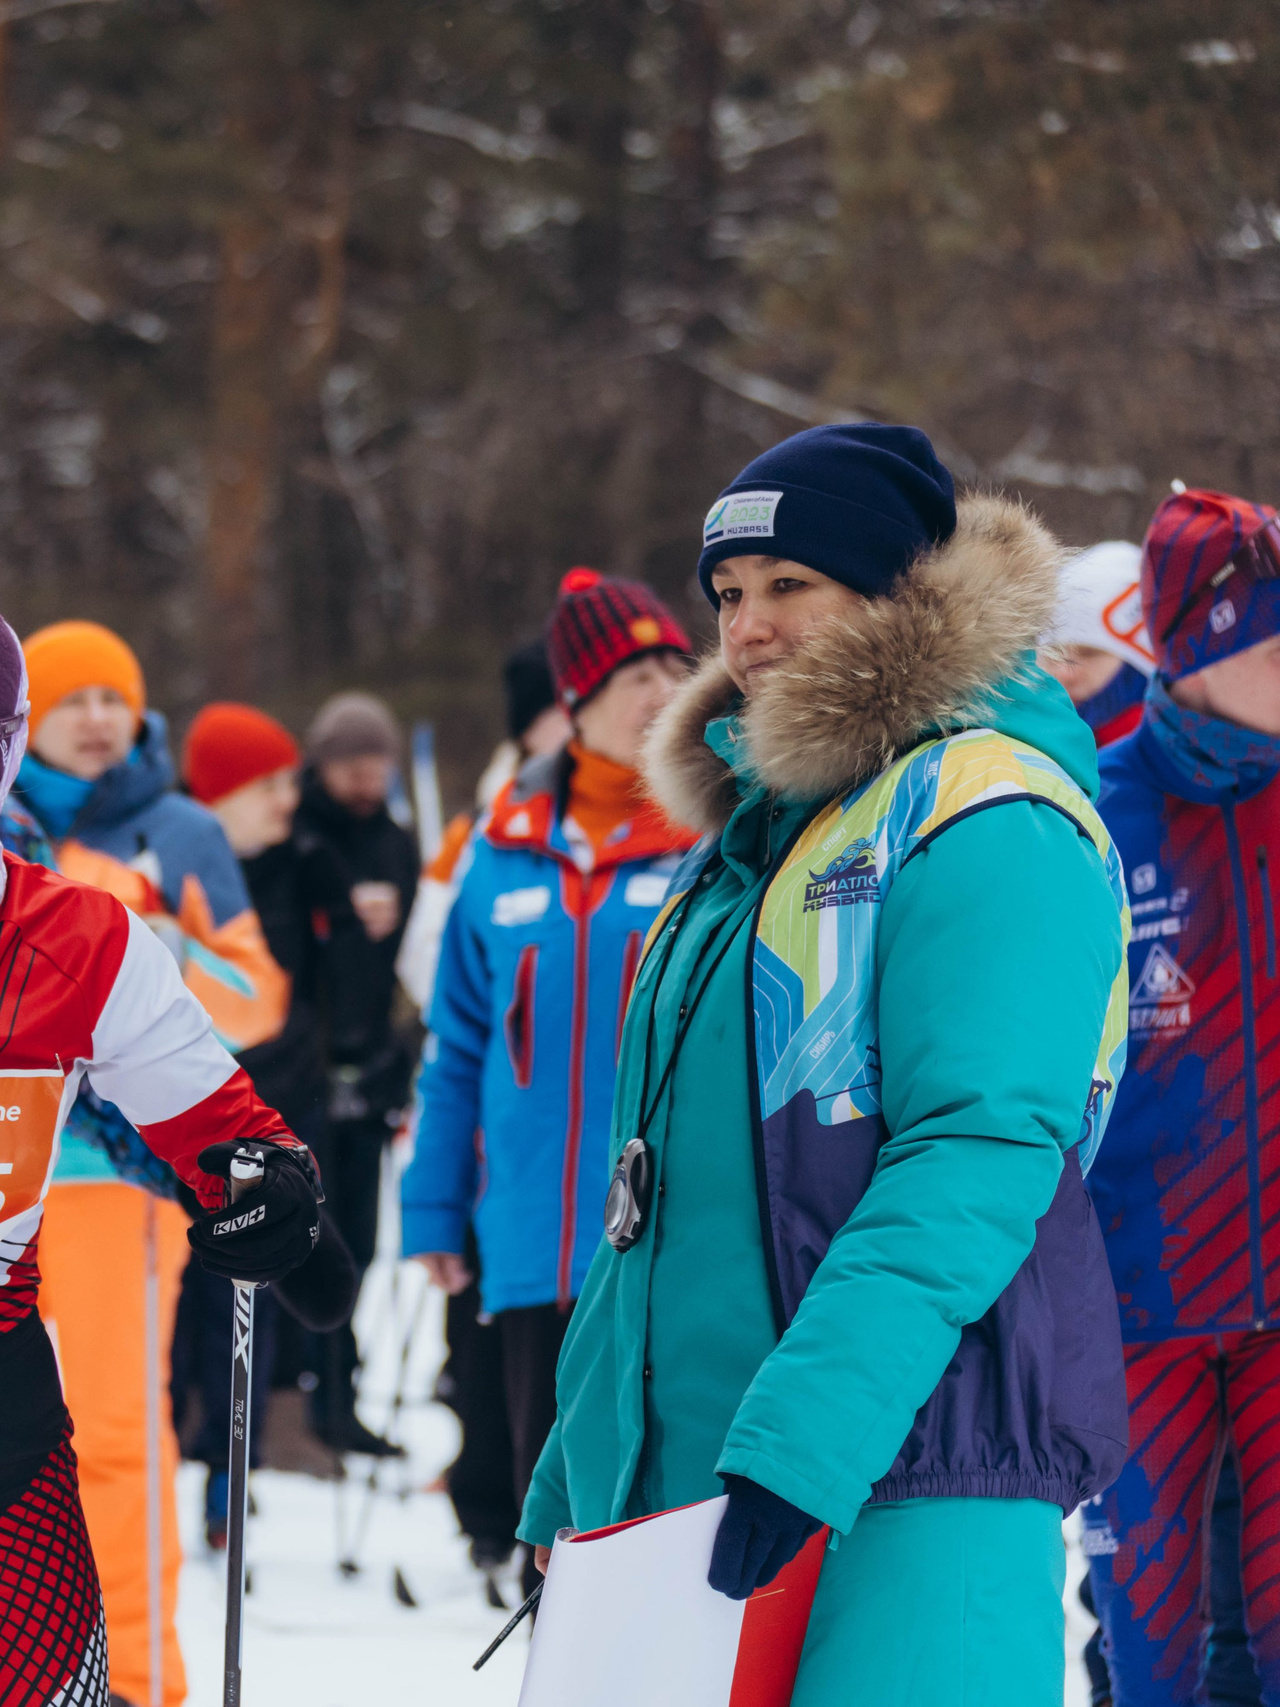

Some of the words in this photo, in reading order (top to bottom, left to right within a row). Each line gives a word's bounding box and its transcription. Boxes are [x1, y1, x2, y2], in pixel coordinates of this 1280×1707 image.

[729, 506, 771, 522] 2023
[727, 525, 769, 535] KUZBASS
[822, 826, 847, 852] СПОРТ
[808, 874, 880, 897] ТРИАТЛО
[802, 890, 881, 913] КУЗБАС
[809, 1030, 836, 1059] СИБИРЬ
